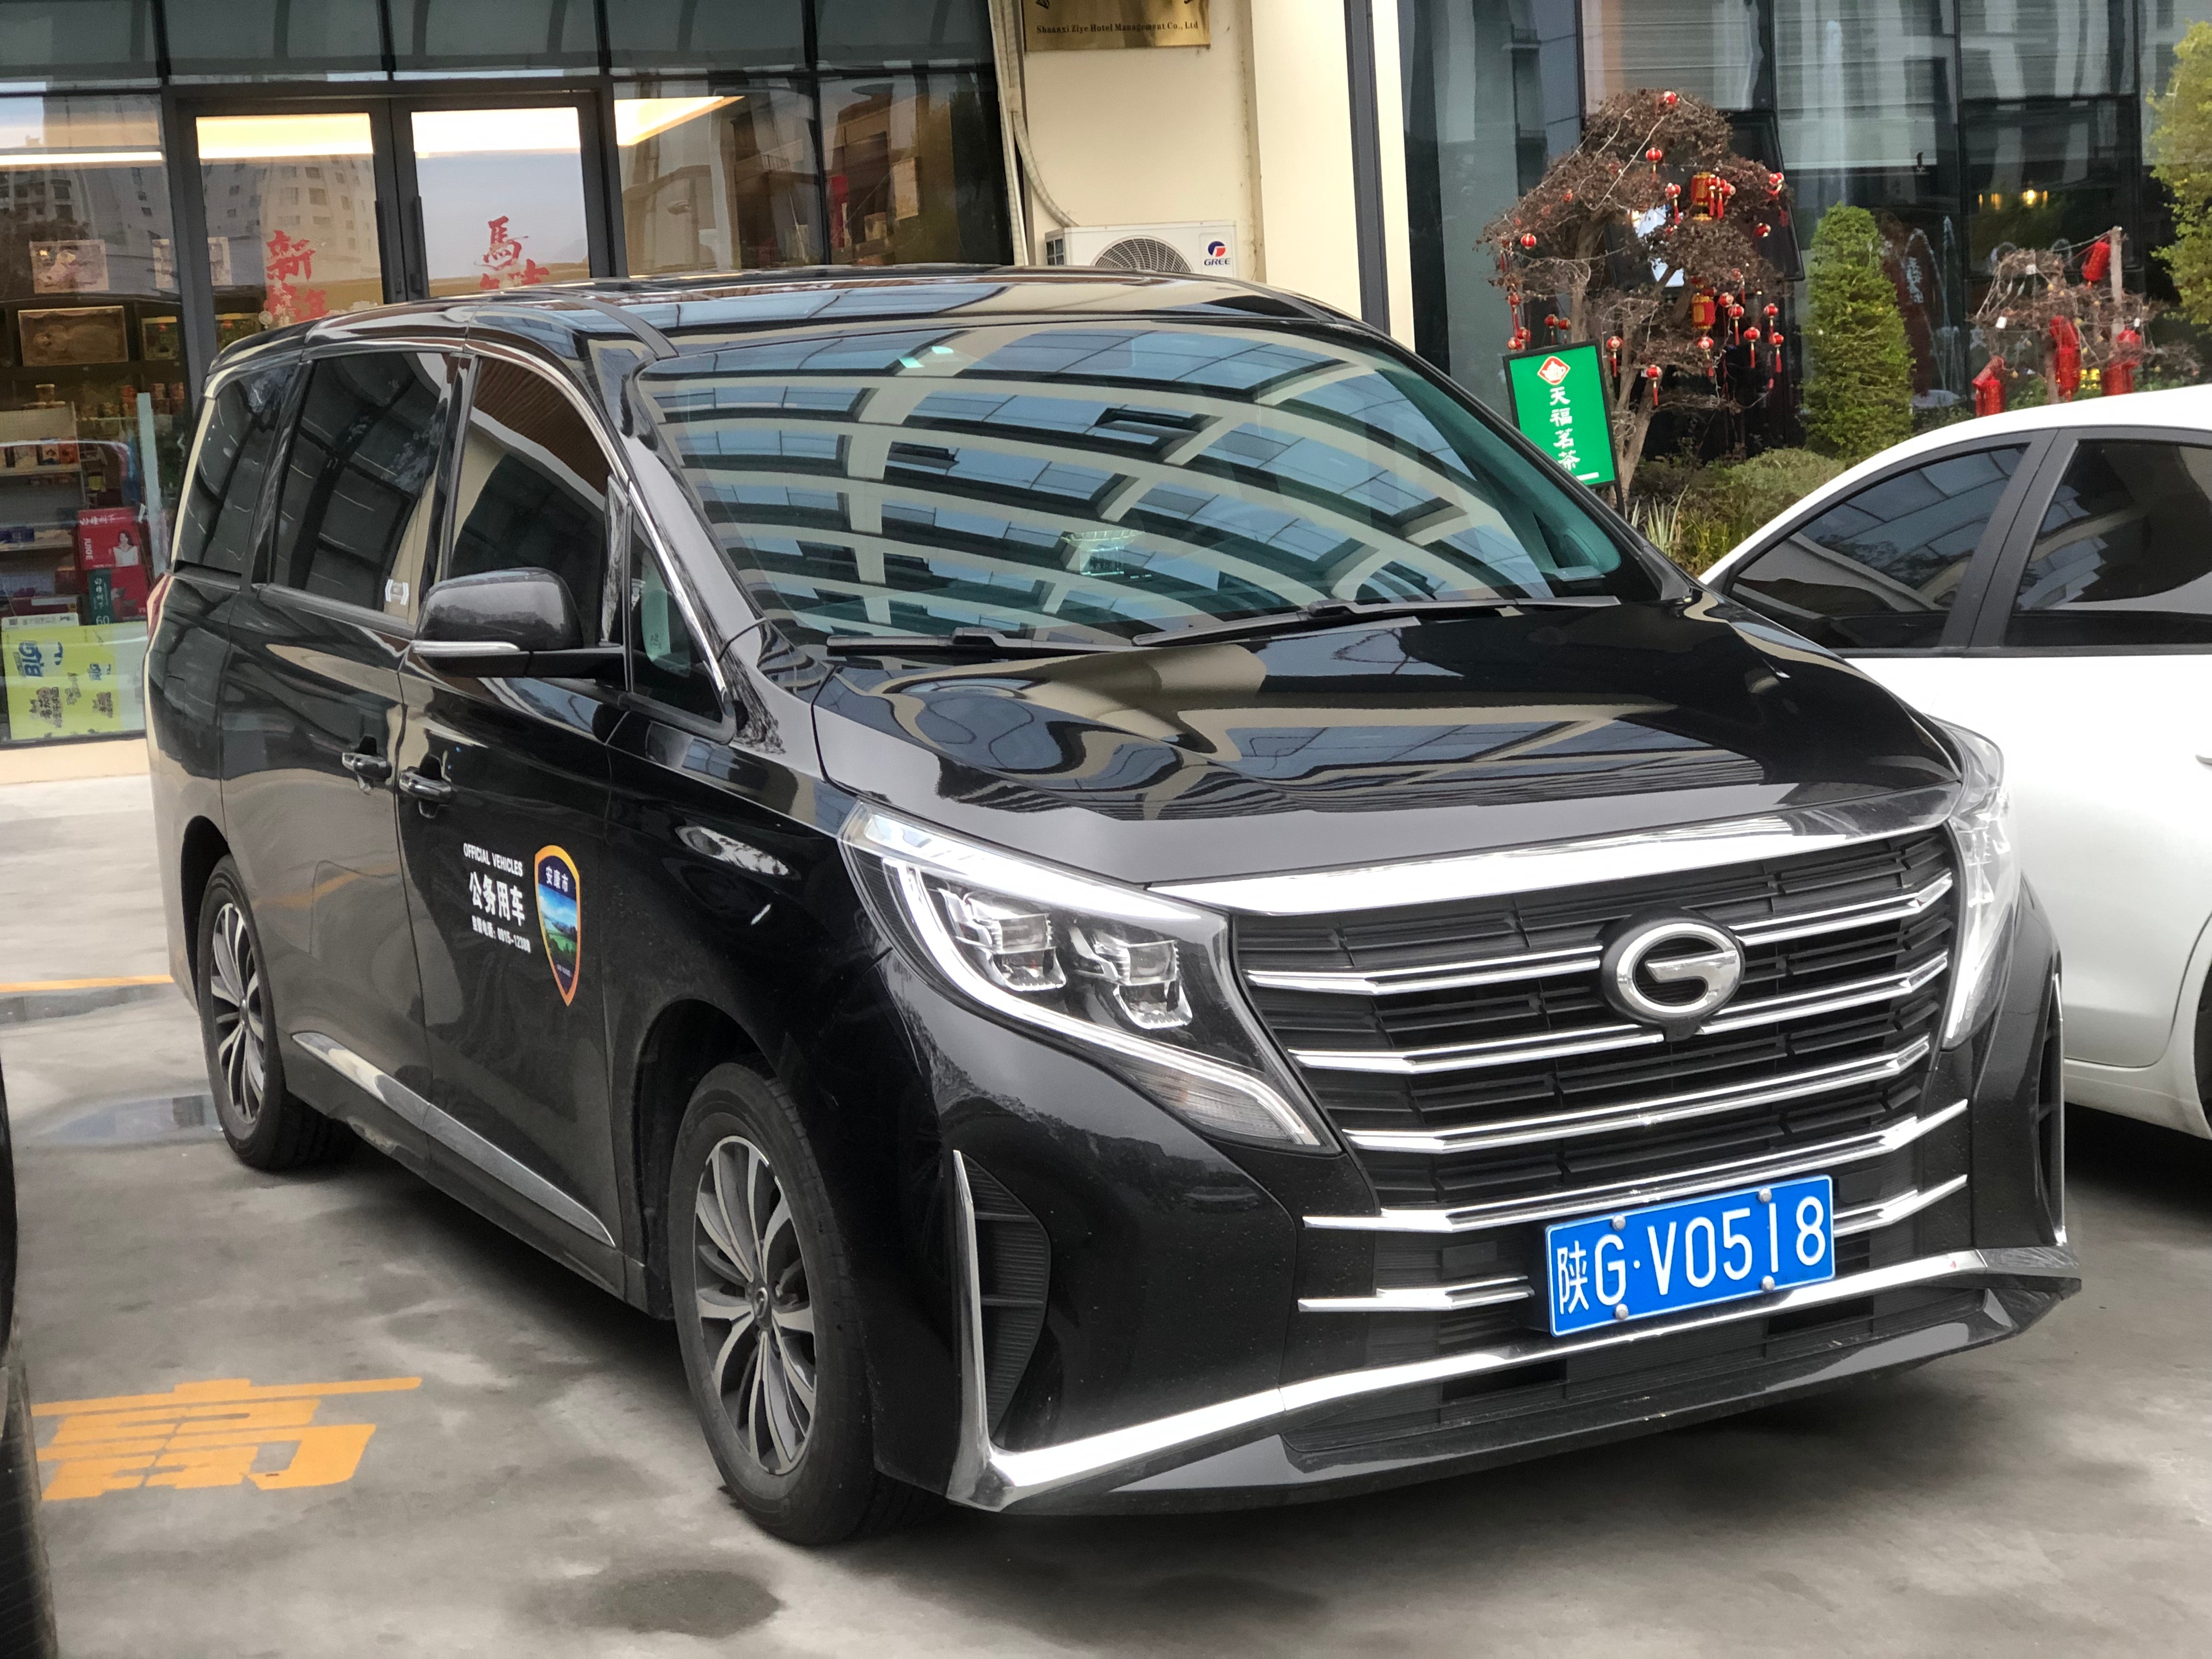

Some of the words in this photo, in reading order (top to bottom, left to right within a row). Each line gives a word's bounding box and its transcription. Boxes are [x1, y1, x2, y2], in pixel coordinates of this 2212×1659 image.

[1037, 25, 1069, 33] Shaanxi
[1071, 24, 1088, 33] Ziye
[1090, 24, 1113, 32] Hotel
[1115, 22, 1165, 32] Management
[1185, 21, 1198, 29] Ltd
[267, 230, 316, 280] 新
[476, 216, 524, 271] 馬
[1204, 258, 1231, 266] GREE
[1549, 386, 1580, 471] 天福茗茶
[96, 616, 109, 624] 60
[19, 640, 43, 677] BIG
[463, 843, 490, 866] OFFICIAL
[492, 853, 523, 877] VEHICLES
[469, 871, 525, 926] 公务用车
[1557, 1195, 1826, 1314] 陕G·V0518
